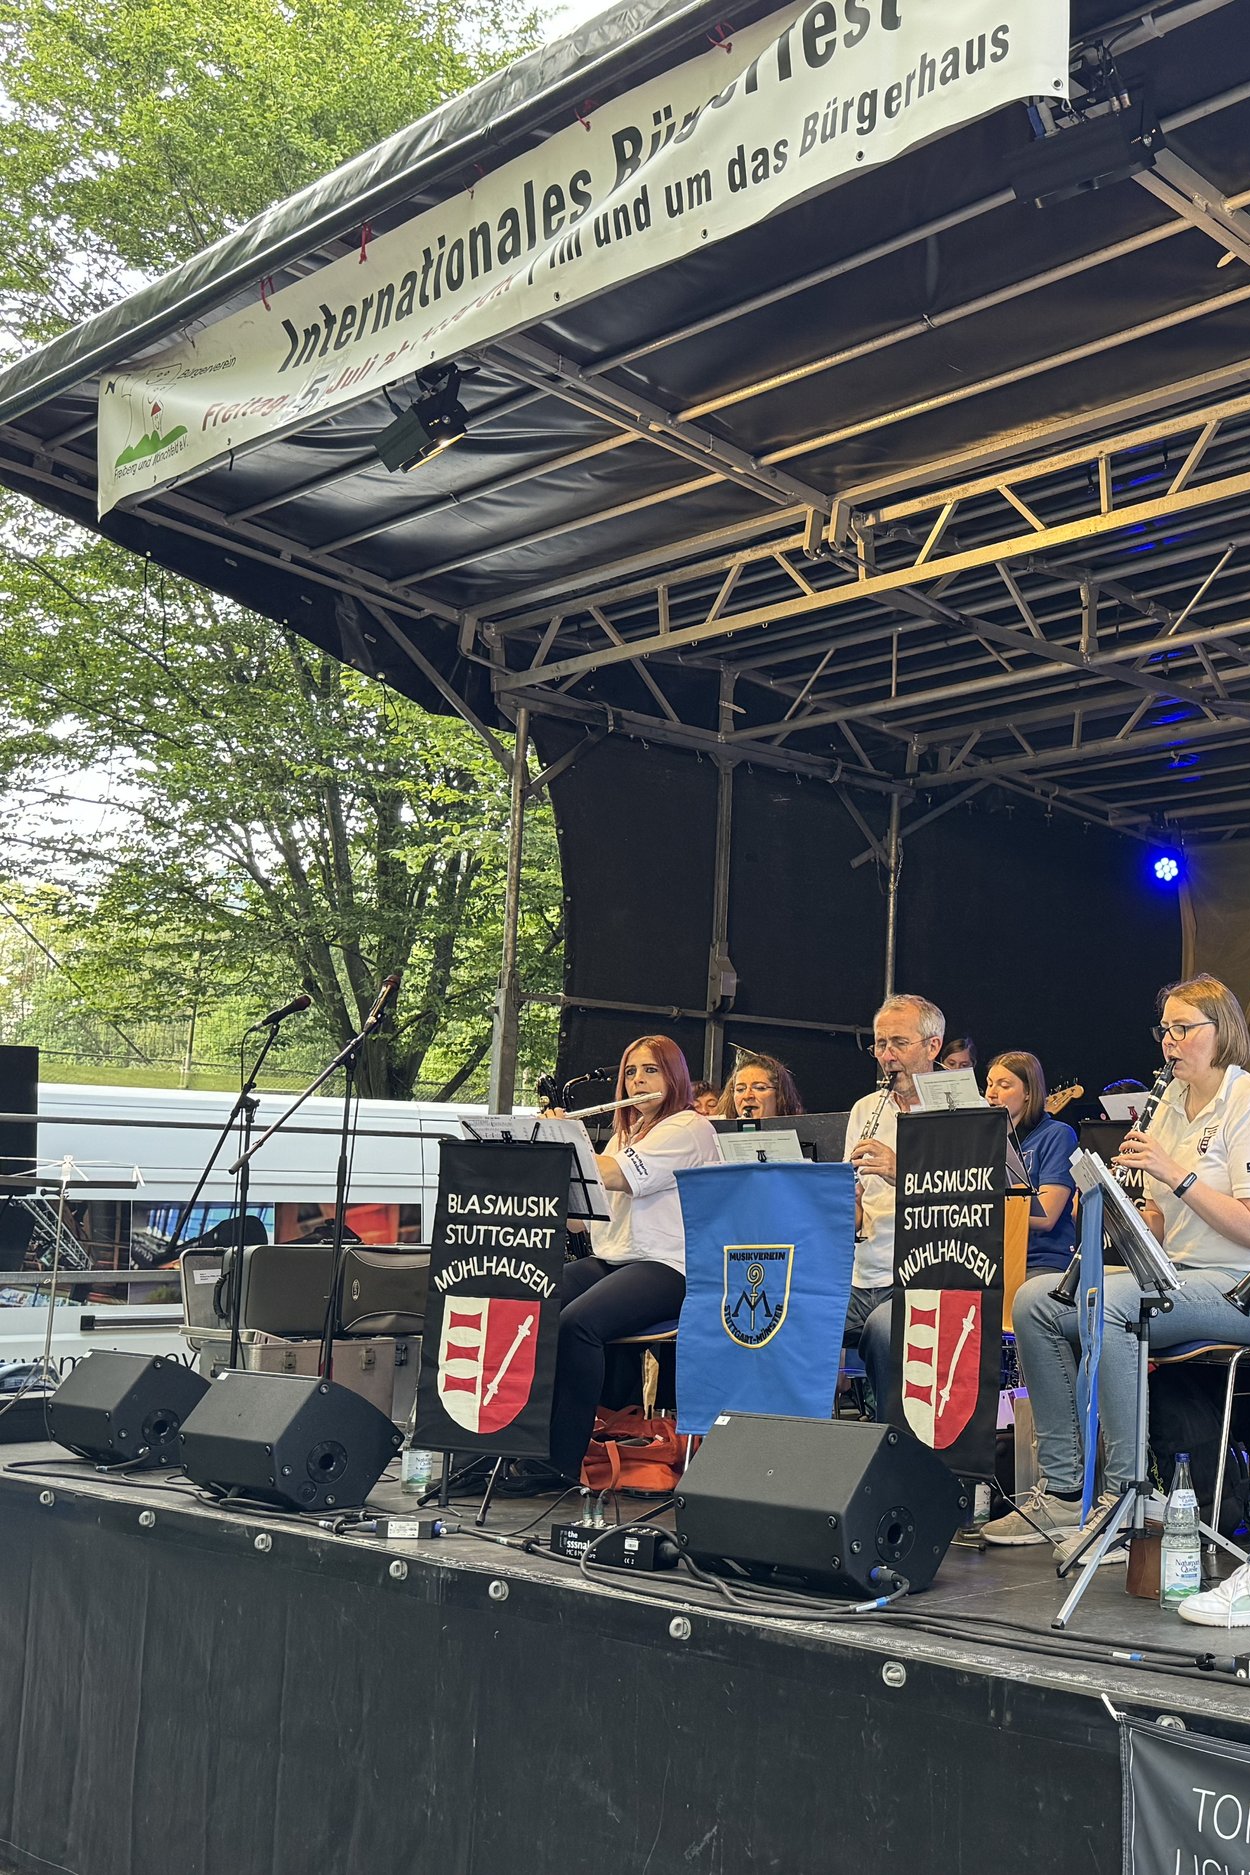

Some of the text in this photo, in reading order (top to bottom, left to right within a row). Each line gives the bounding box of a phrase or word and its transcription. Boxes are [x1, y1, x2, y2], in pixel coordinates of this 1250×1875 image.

[594, 184, 652, 249] und
[664, 168, 713, 218] um
[728, 138, 789, 194] das
[799, 24, 1010, 158] Bürgerhaus
[277, 0, 902, 374] Internationales Büfest
[177, 355, 237, 379] Bürgerverein
[326, 353, 379, 394] Juli
[904, 1167, 994, 1196] BLASMUSIK
[447, 1193, 560, 1218] BLASMUSIK
[904, 1203, 994, 1230] STUTTGART
[444, 1223, 556, 1249] STUTTGART
[729, 1251, 786, 1262] MUSIKVEREIN
[898, 1238, 998, 1287] MÜHLHAUSEN
[433, 1255, 556, 1299] MÜHLHAUSEN
[723, 1303, 785, 1345] STUTTGART-MÜNSTER
